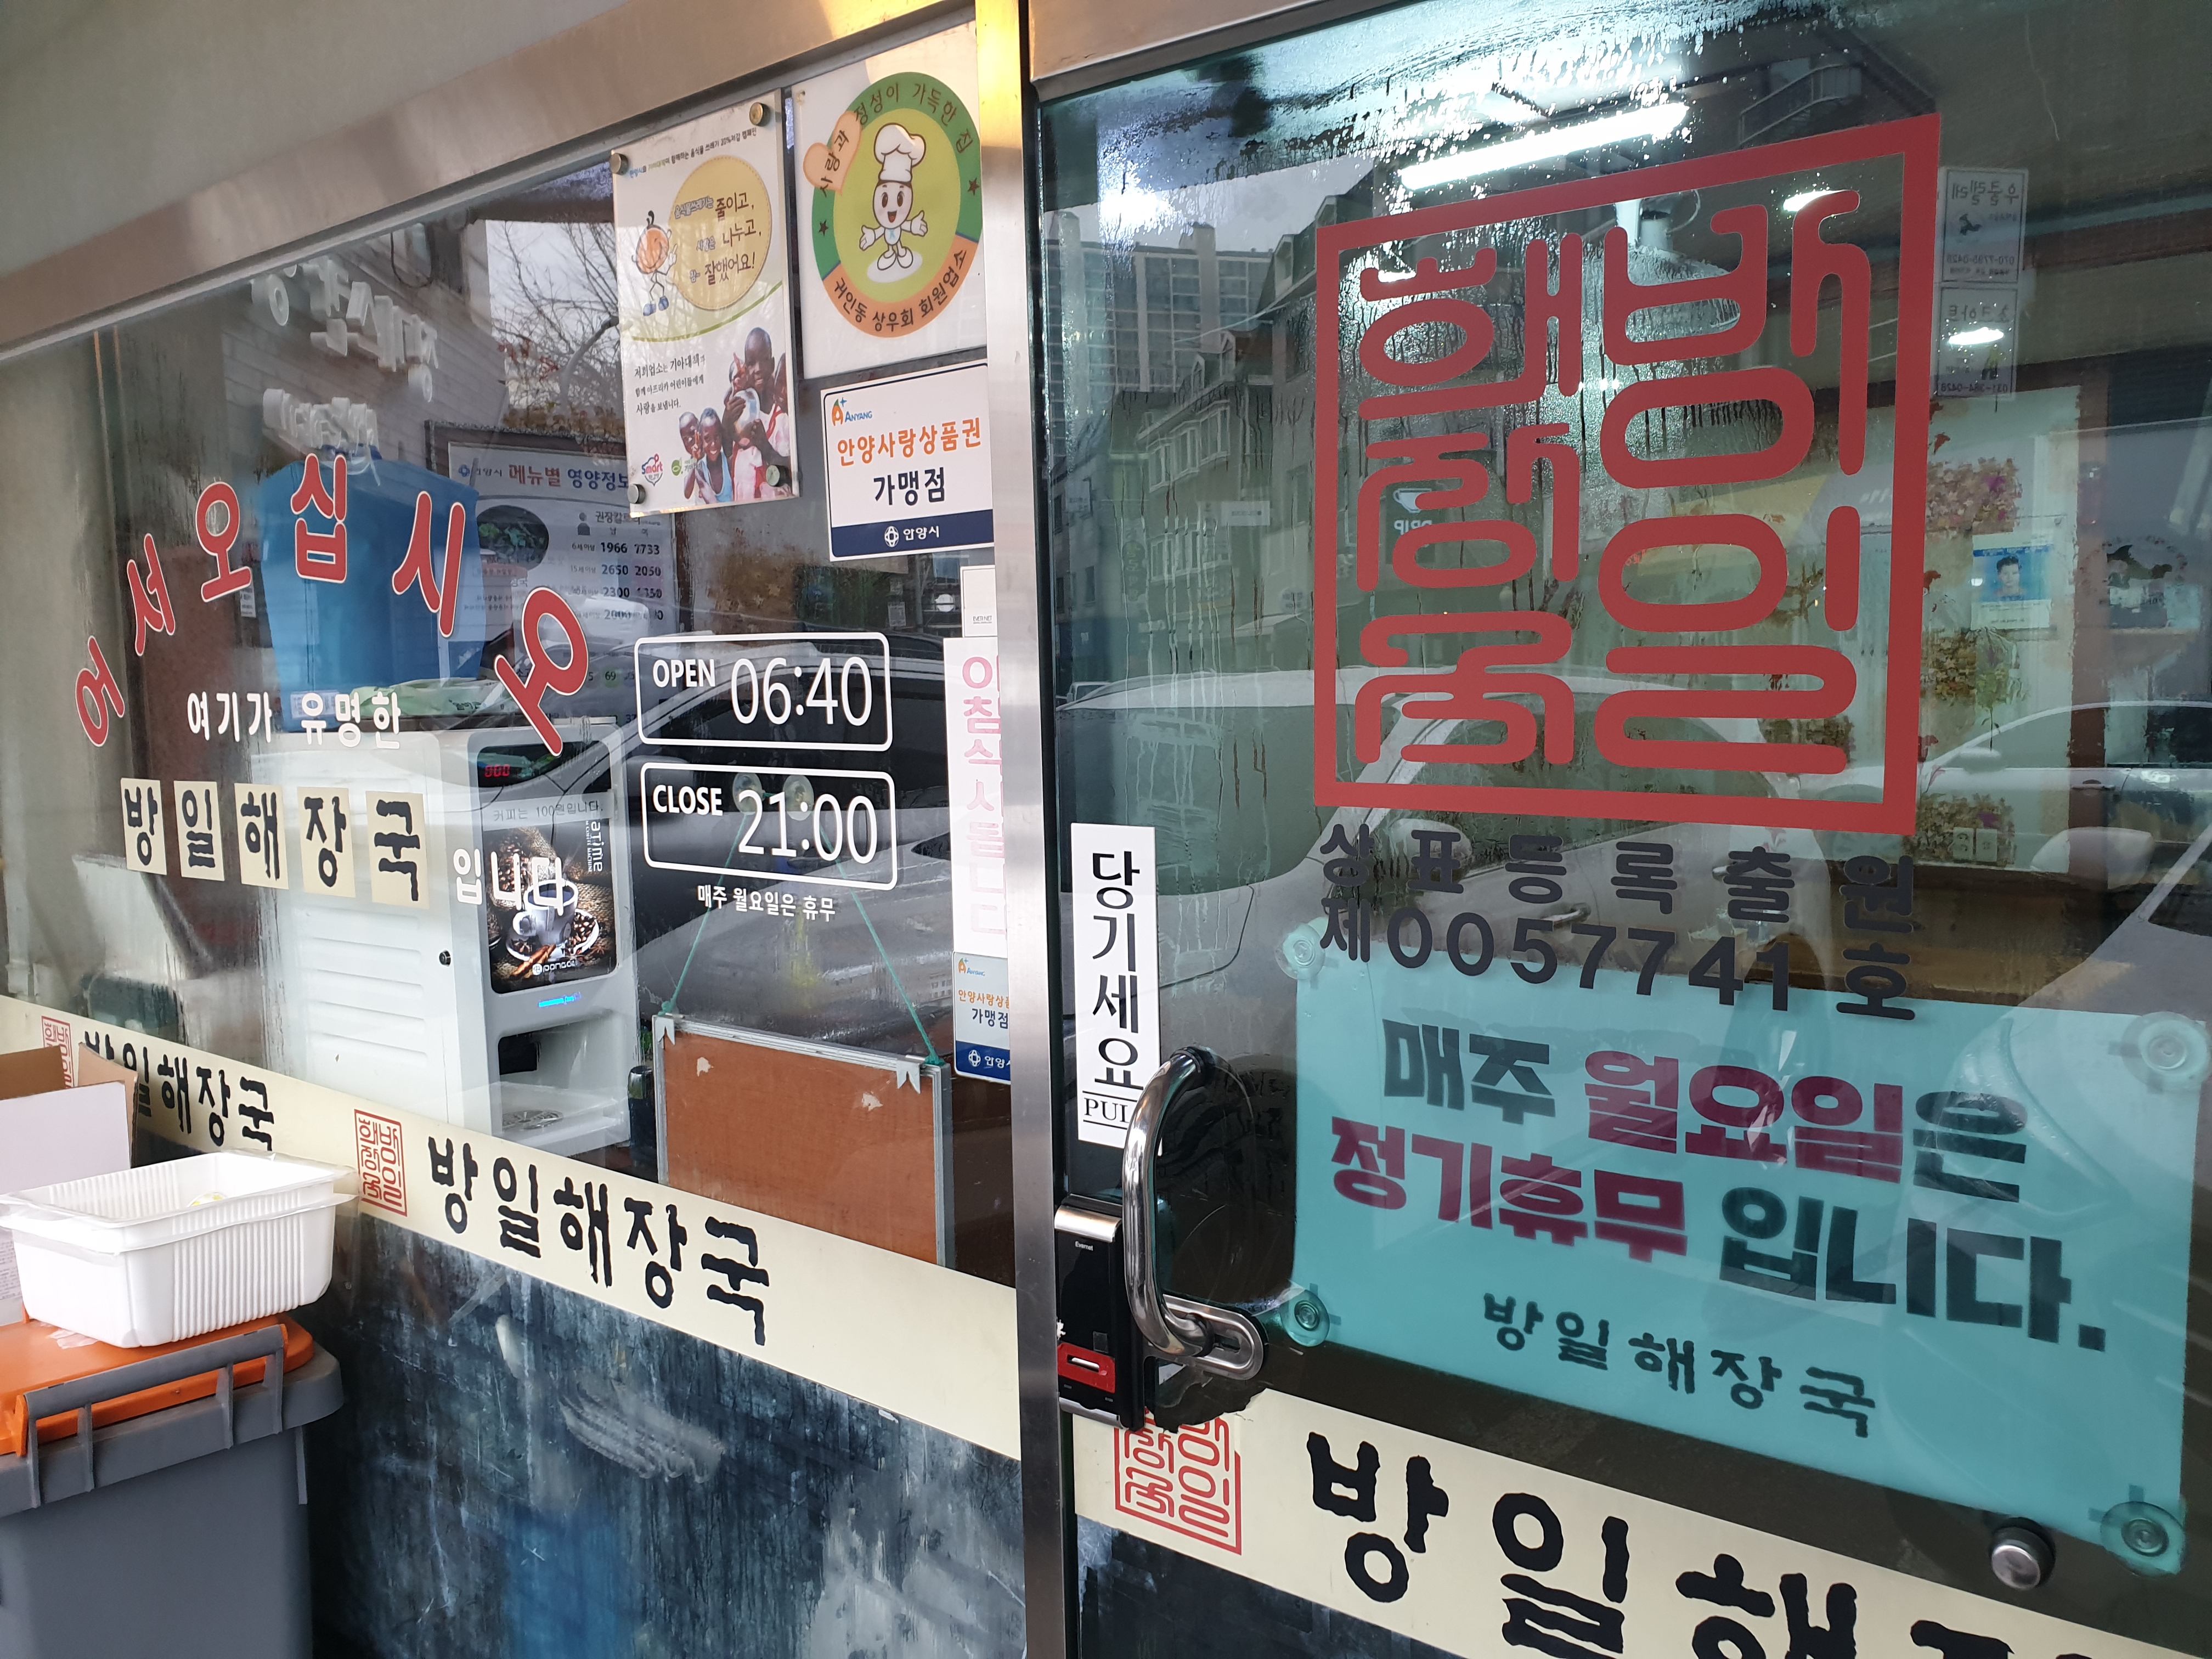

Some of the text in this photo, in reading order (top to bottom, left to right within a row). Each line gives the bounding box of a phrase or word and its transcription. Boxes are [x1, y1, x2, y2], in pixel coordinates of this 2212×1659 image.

[705, 140, 719, 151] 쓰레기
[820, 83, 974, 197] 사랑과 정성이 가득한 집
[723, 219, 762, 247] 나누고,
[705, 251, 755, 286] 잘했어요!
[833, 249, 967, 332] 귀인동 상우회 회원업소
[635, 353, 706, 379] 저희업소는 기아대책과
[647, 381, 669, 394] 아프리카
[670, 374, 704, 390] 어린이들에게
[636, 398, 681, 416] 사랑을 보냅니다.
[845, 411, 873, 422] ANYANG
[837, 417, 981, 467] 안양사랑상품권
[509, 464, 561, 488] 메뉴별
[567, 468, 628, 492] 영양정보
[873, 466, 945, 506] 가맹점
[601, 541, 628, 554] 1966
[903, 525, 940, 541] 안양시
[602, 564, 629, 575] 2650
[603, 586, 630, 598] 2300
[653, 657, 872, 726] OPEN 06:40
[187, 691, 402, 750] 여기가 유명한
[493, 800, 603, 822] 커피는 100원입니다.
[653, 785, 878, 865] CLOSE 21:00
[453, 848, 565, 917] 입니다
[697, 884, 836, 923] 매주 월요일은 휴무
[1092, 851, 1144, 1090] 당기세요
[972, 1008, 1008, 1029] 가맹점
[1084, 1097, 1131, 1125] PUL
[1381, 1017, 2030, 1205] 매주 월요일은
[428, 1136, 769, 1346] 방일해장국
[1075, 1241, 1093, 1251] Evernet
[1330, 1115, 2108, 1353] 정기휴무 입니다.
[1483, 1291, 1876, 1439] 방일해장국
[1307, 1431, 2095, 1659] 방일해
